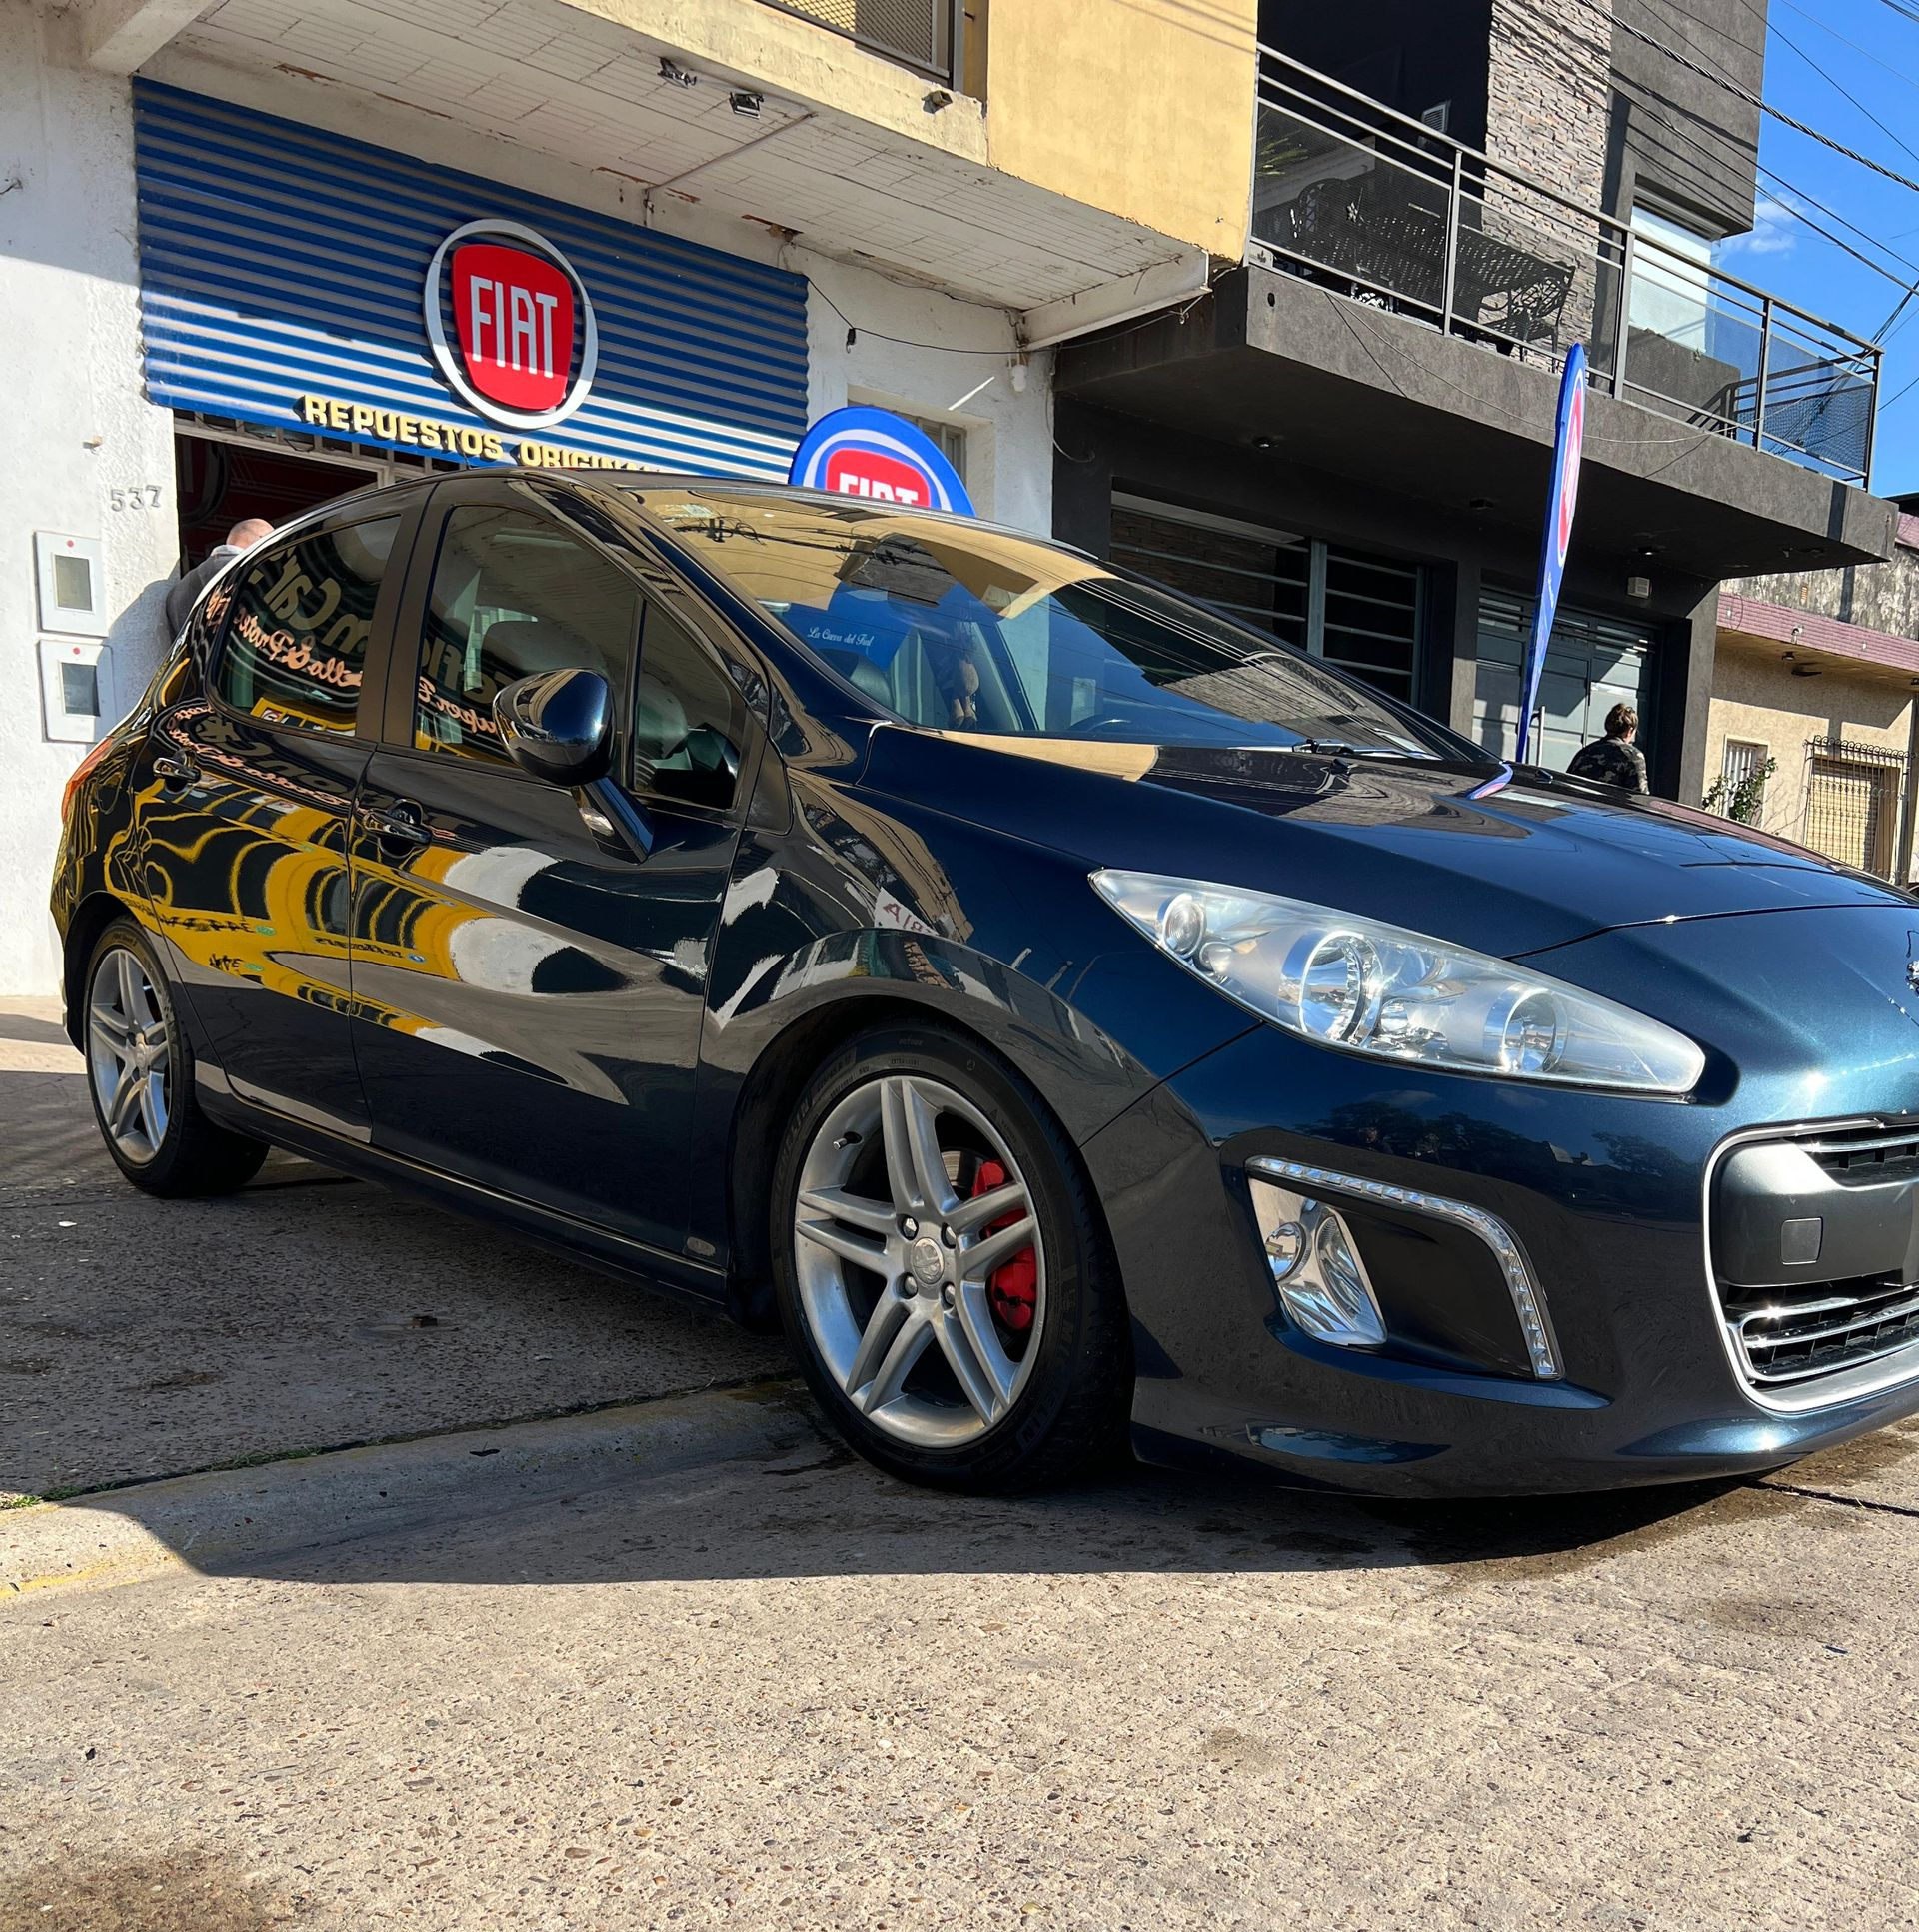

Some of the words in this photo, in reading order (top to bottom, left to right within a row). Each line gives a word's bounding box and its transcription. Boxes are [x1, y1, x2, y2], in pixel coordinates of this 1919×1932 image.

[470, 274, 558, 379] FIAT
[303, 394, 504, 460] REPUESTOS
[110, 484, 162, 512] 537
